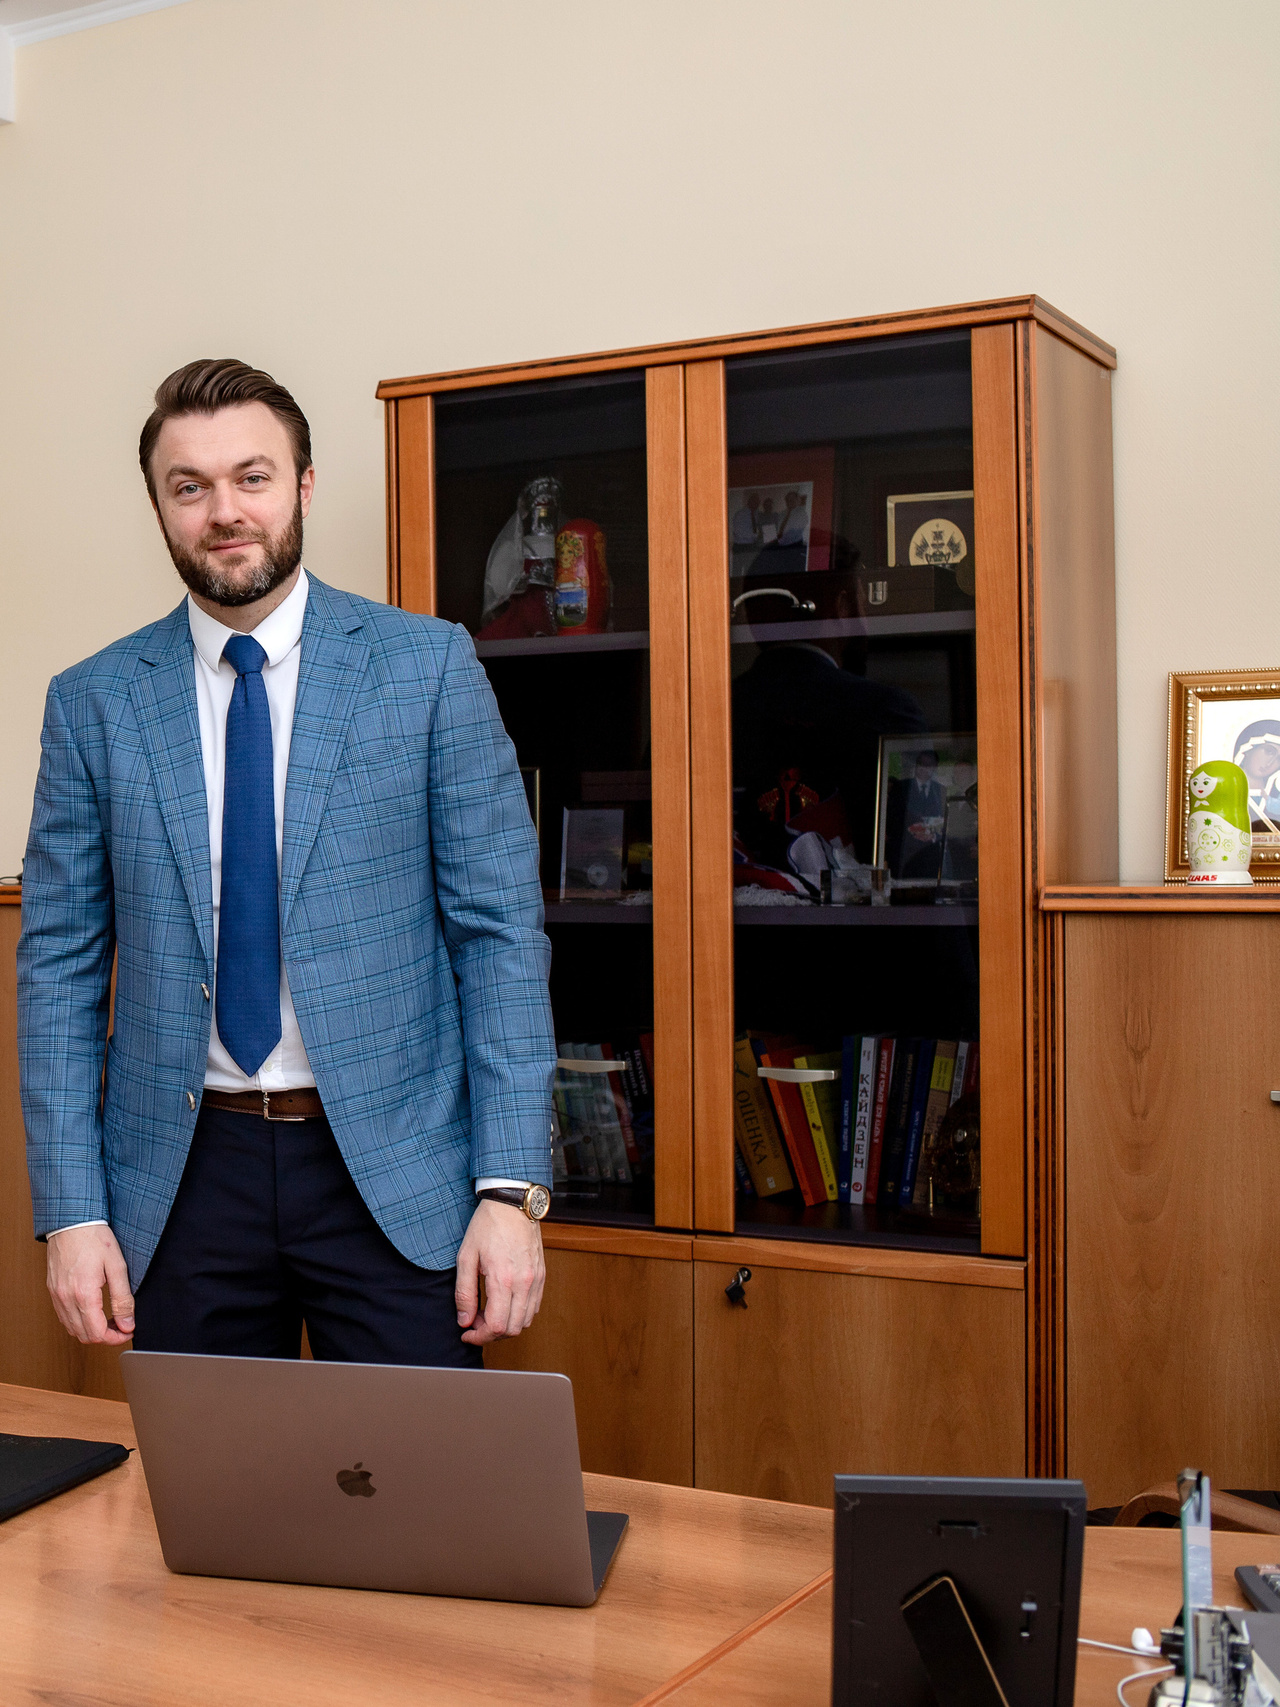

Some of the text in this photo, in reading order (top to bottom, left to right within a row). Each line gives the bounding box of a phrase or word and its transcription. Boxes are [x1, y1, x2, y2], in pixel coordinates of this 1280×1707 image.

[633, 1048, 649, 1096] Искусство
[736, 1089, 767, 1165] ОЦЕНКА
[853, 1073, 870, 1169] КАЙДЗЕН
